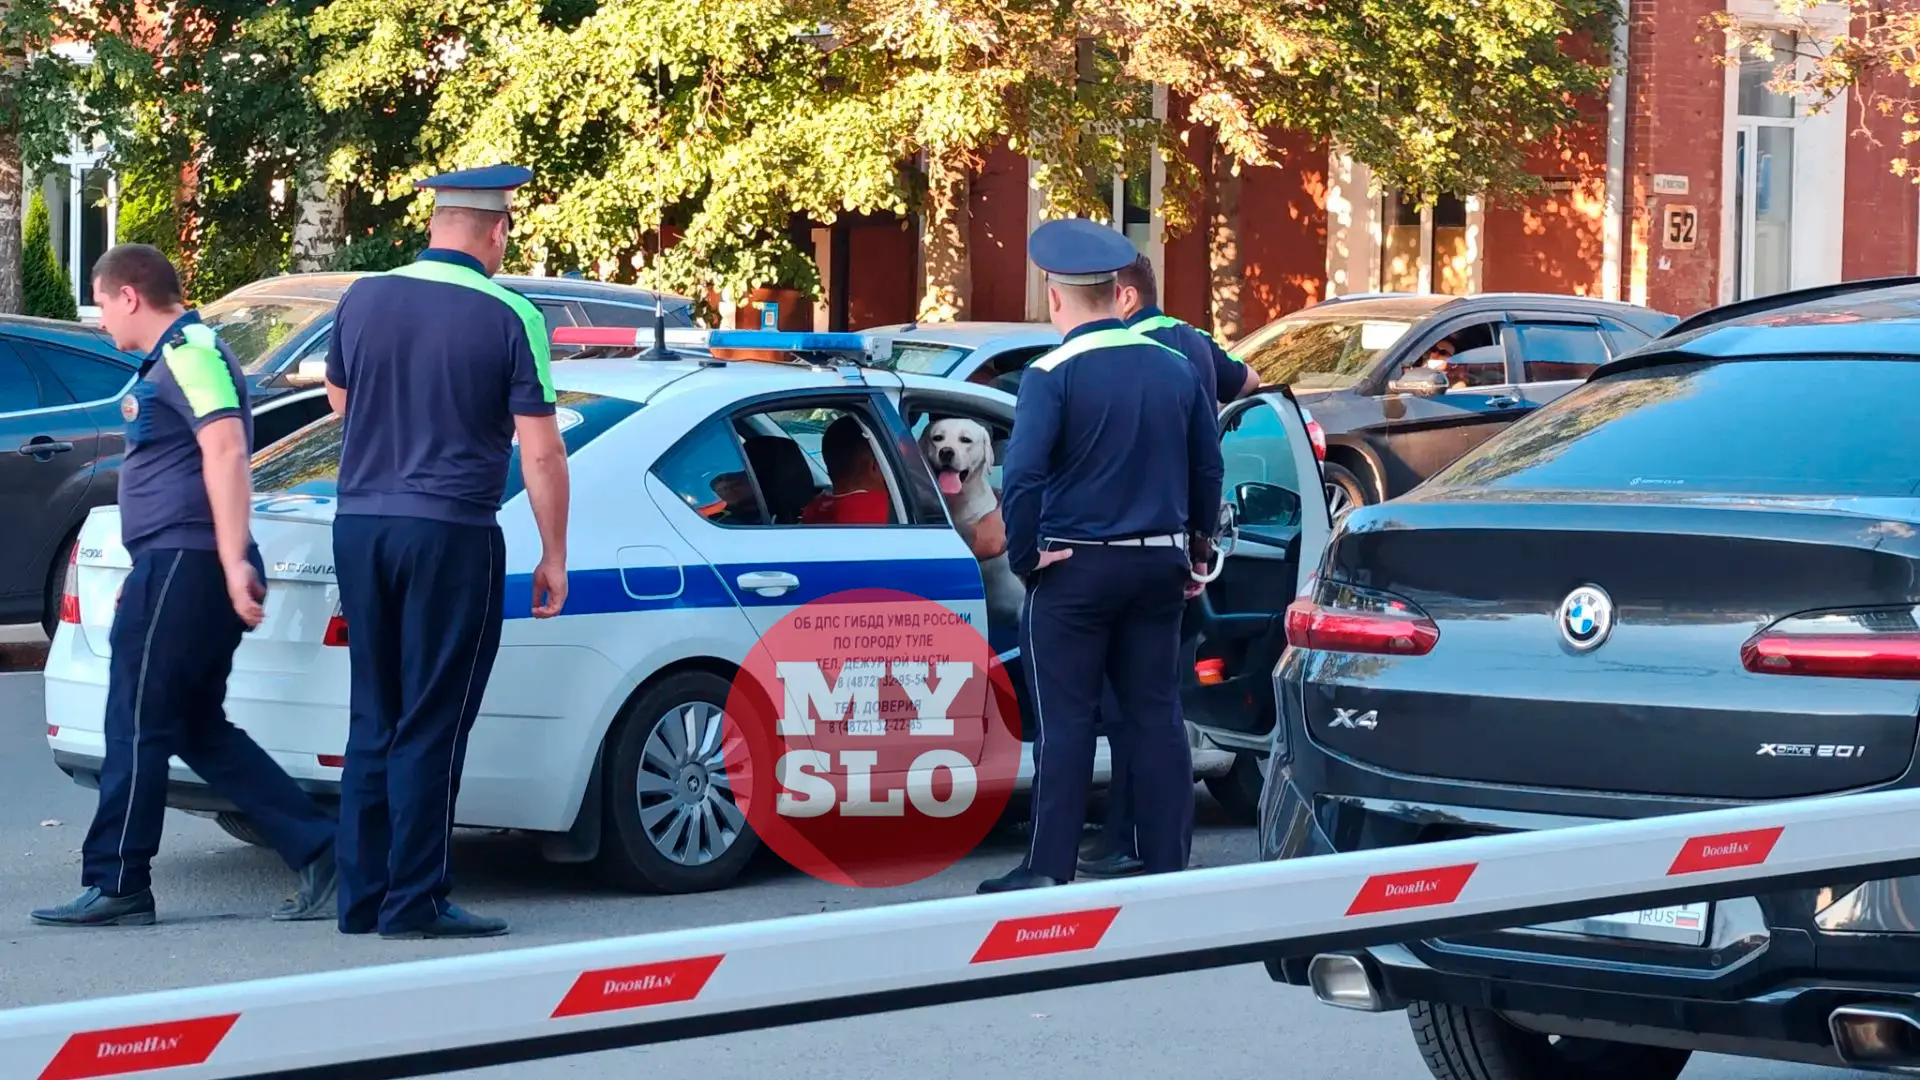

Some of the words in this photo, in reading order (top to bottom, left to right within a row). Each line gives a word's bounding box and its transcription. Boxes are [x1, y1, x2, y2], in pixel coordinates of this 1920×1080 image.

[1670, 211, 1694, 243] 52
[274, 562, 336, 575] OCTAVIA
[794, 616, 812, 630] ОБ
[815, 615, 840, 631] ДПС
[844, 614, 884, 630] ГИБДД
[887, 613, 920, 628] УМВД
[924, 612, 972, 627] РОССИИ
[833, 636, 850, 649] ПО
[855, 634, 902, 650] ГОРОДУ
[906, 634, 933, 648] ТУЛЕ
[816, 658, 841, 670] ТЕЛ.
[844, 653, 909, 671] ДЕЖУРНОЙ
[912, 654, 950, 668] ЧАСТИ
[837, 677, 843, 689] 8
[834, 702, 860, 715] ТЕЛ.
[863, 699, 922, 715] ДОВЕРИЯ
[1328, 707, 1378, 730] X4
[1643, 908, 1675, 924] RUS
